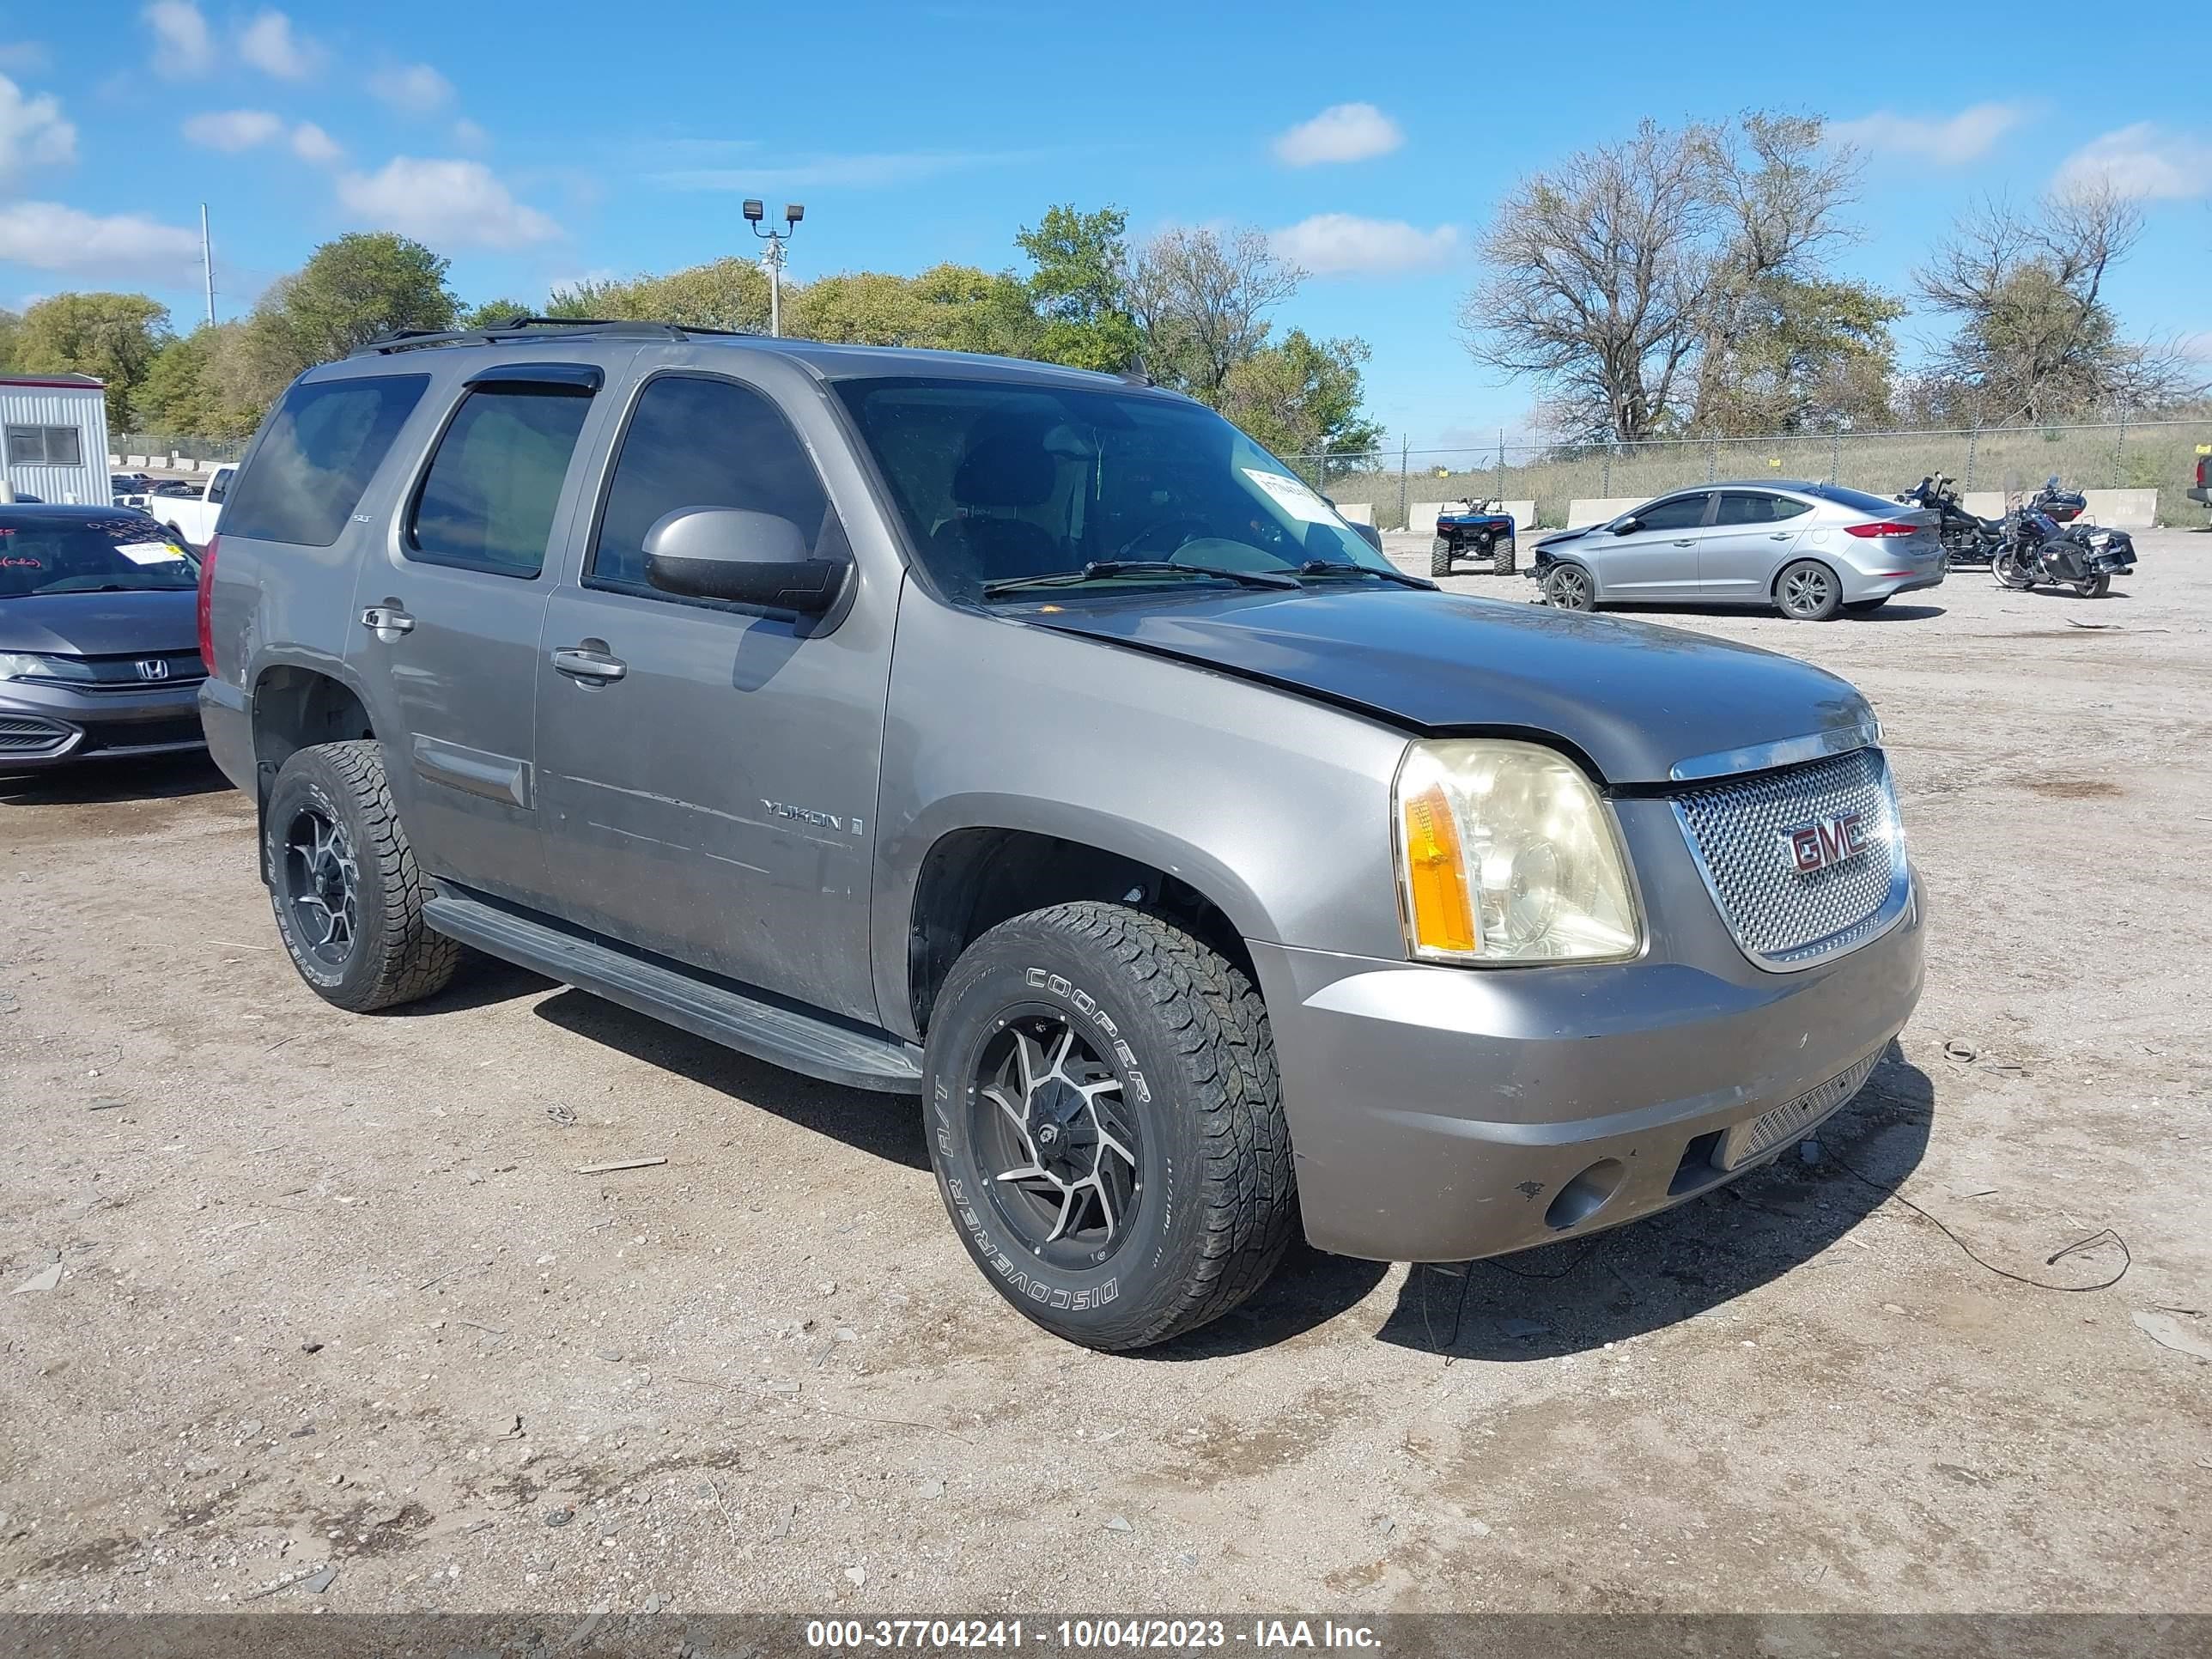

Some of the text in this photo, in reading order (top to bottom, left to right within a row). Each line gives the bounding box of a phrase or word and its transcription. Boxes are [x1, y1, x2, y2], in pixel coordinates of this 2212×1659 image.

[760, 799, 843, 831] YUKON
[1790, 814, 1869, 874] GMC
[1025, 967, 1152, 1103] COOPER
[934, 1074, 1120, 1311] DISCOVERER A/T
